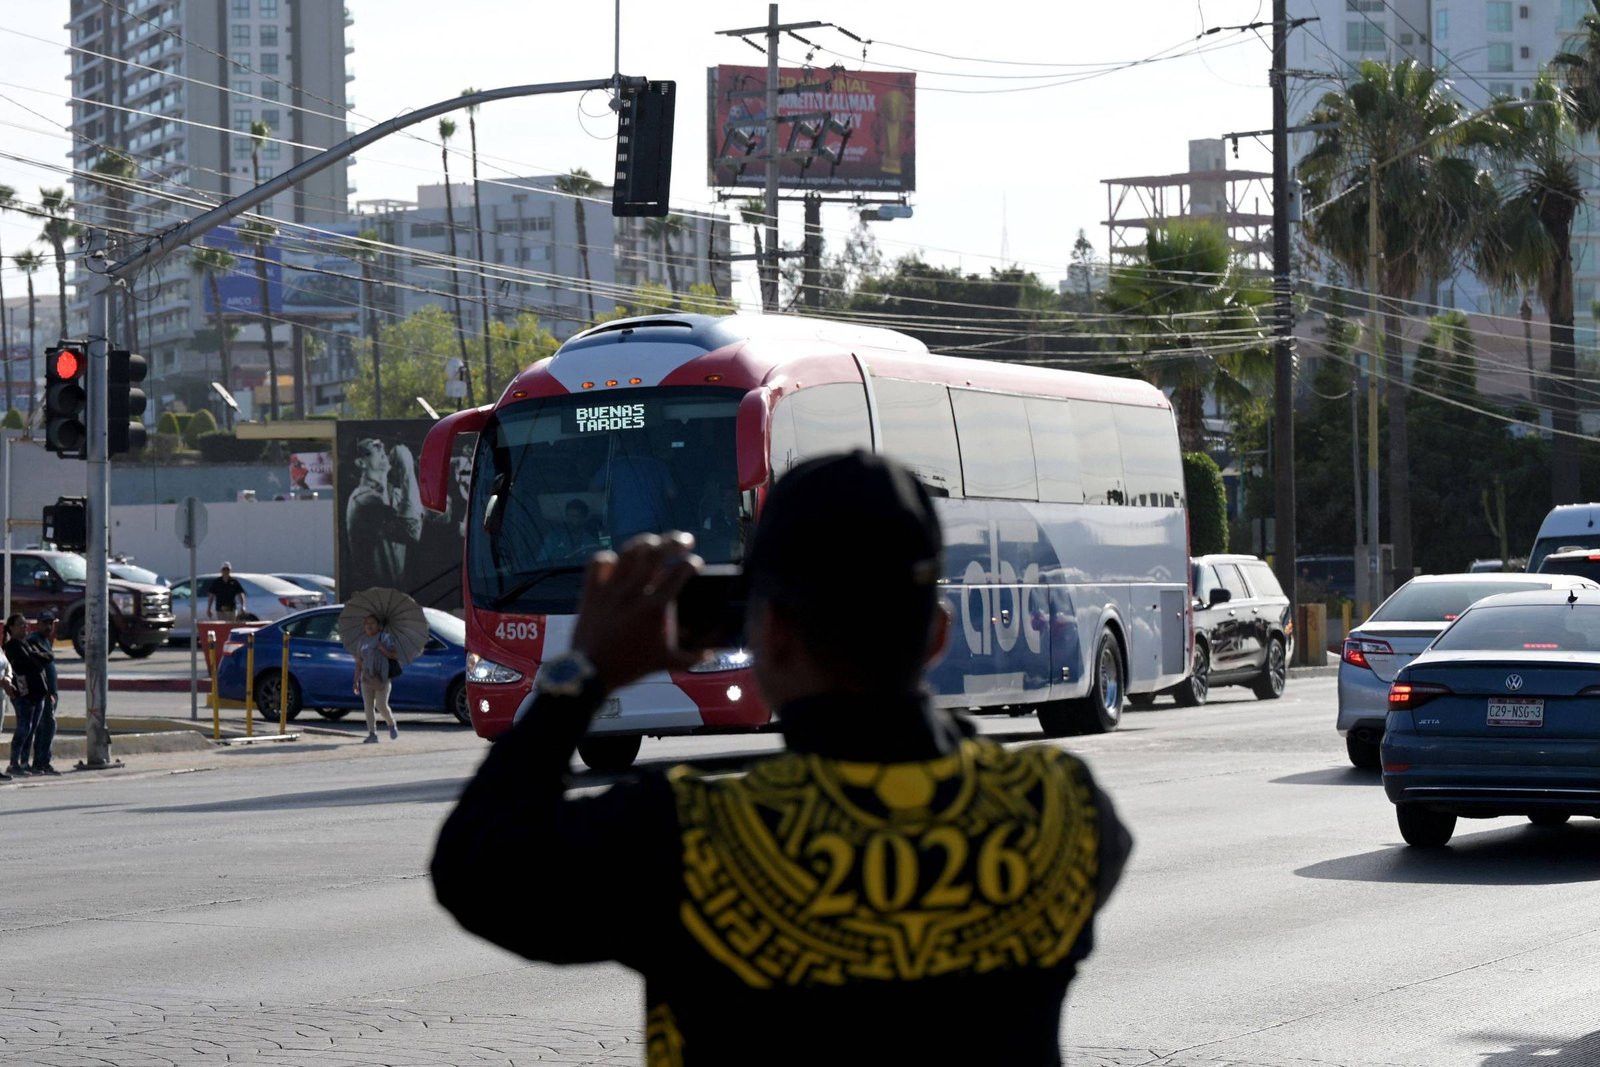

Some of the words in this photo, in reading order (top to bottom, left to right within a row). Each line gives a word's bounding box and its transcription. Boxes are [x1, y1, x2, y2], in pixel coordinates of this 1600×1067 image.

[576, 404, 645, 420] BUENAS
[576, 416, 645, 432] TARDES
[495, 622, 539, 640] 4503
[1489, 705, 1541, 718] C29-NSG-3
[800, 824, 1034, 920] 2026
